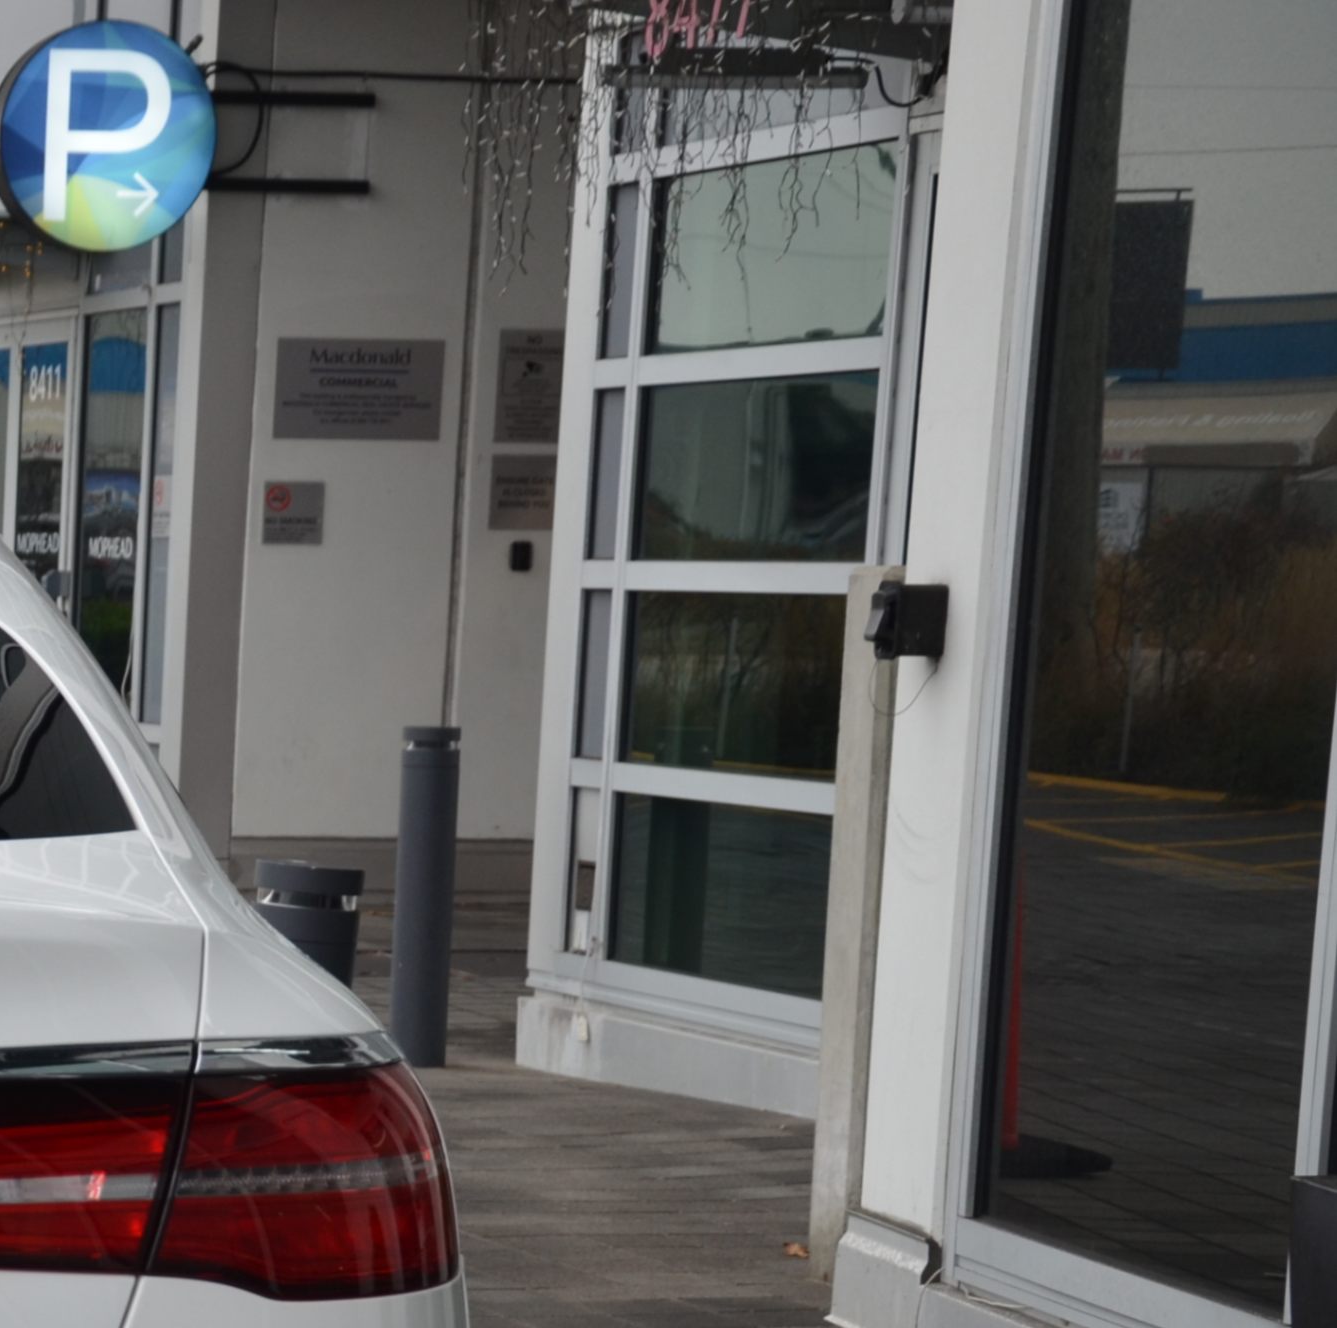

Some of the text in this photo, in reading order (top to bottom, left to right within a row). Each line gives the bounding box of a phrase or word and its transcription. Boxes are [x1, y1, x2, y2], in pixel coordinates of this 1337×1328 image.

[43, 48, 172, 222] P
[310, 347, 412, 365] Macdonald
[29, 363, 62, 402] 8411
[17, 532, 61, 554] MOPHEAD
[88, 536, 134, 559] MOPHEAD
